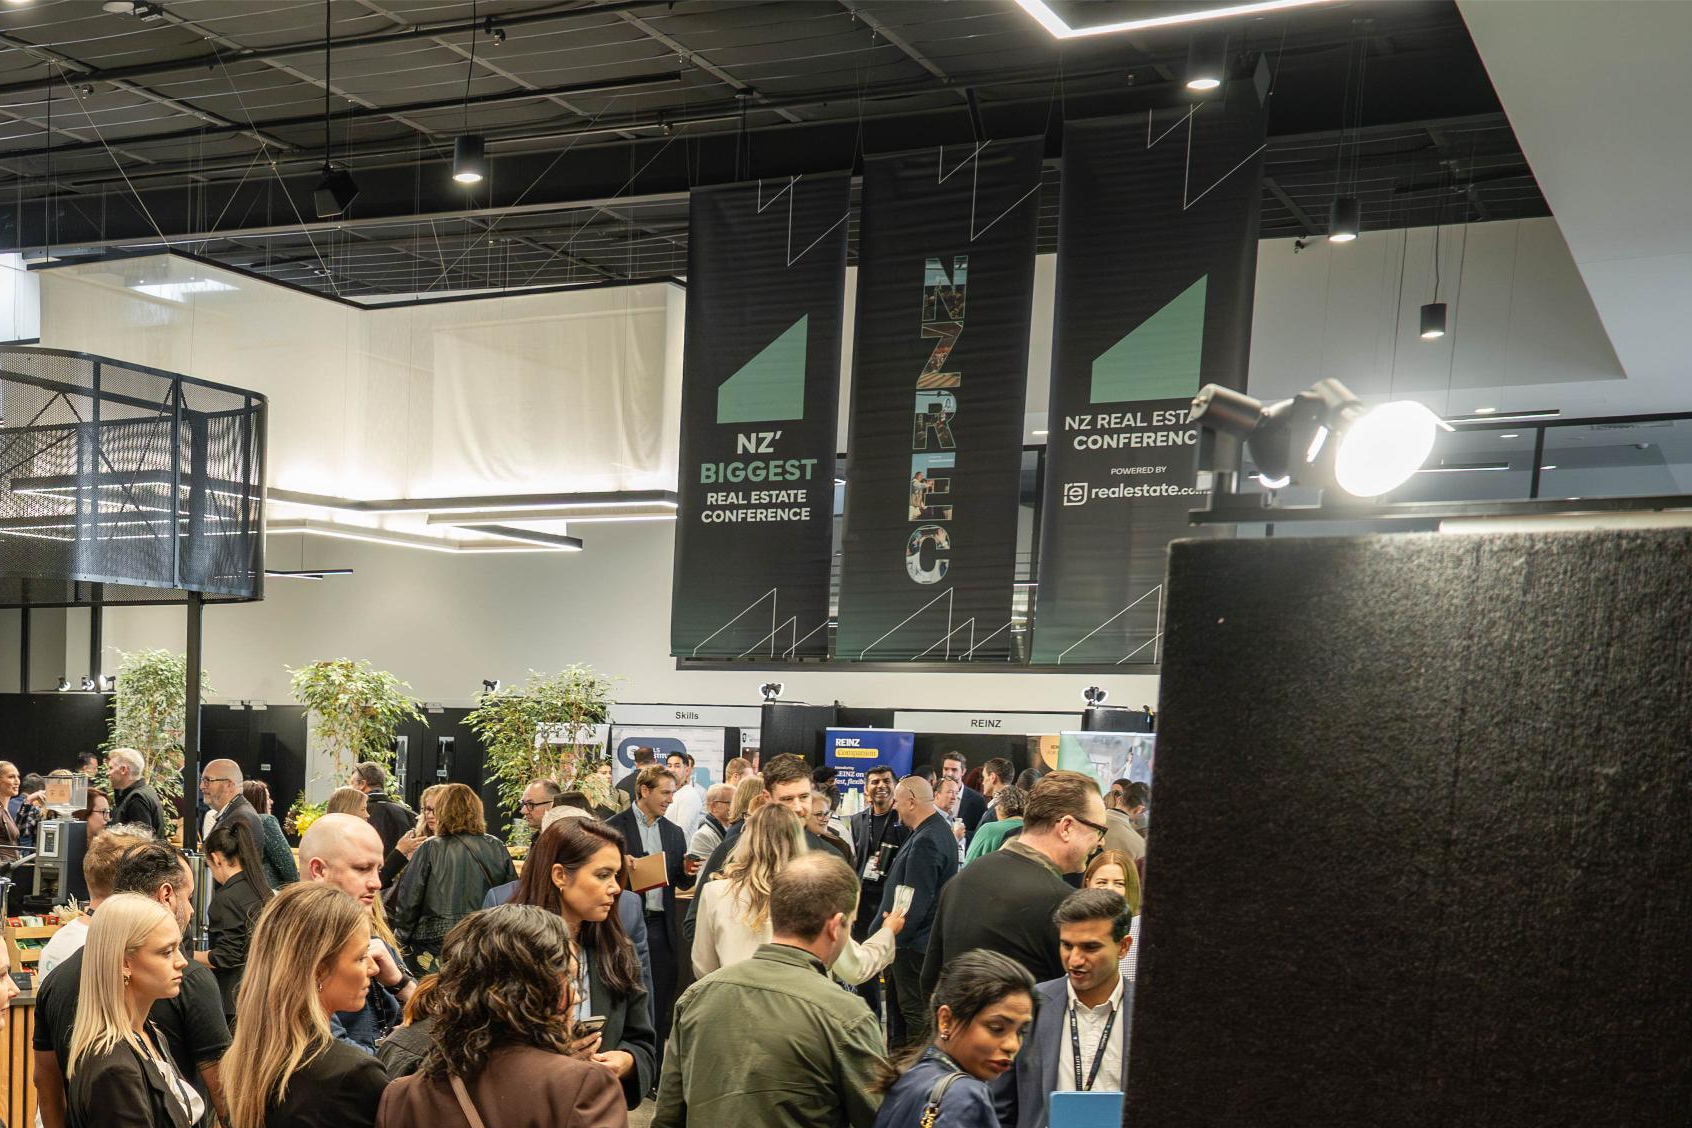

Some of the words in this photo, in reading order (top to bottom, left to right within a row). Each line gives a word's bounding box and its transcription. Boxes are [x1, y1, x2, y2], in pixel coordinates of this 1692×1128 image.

[905, 256, 969, 585] NZREC
[1064, 415, 1092, 431] NZ
[1097, 412, 1148, 429] REAL
[700, 459, 818, 484] BIGGEST
[1110, 467, 1154, 475] POWERED
[707, 492, 747, 505] REAL
[751, 490, 807, 504] ESTATE
[701, 508, 810, 523] CONFERENCE
[675, 711, 699, 720] Skills
[971, 719, 1001, 728] REINZ
[835, 738, 860, 747] REINZ
